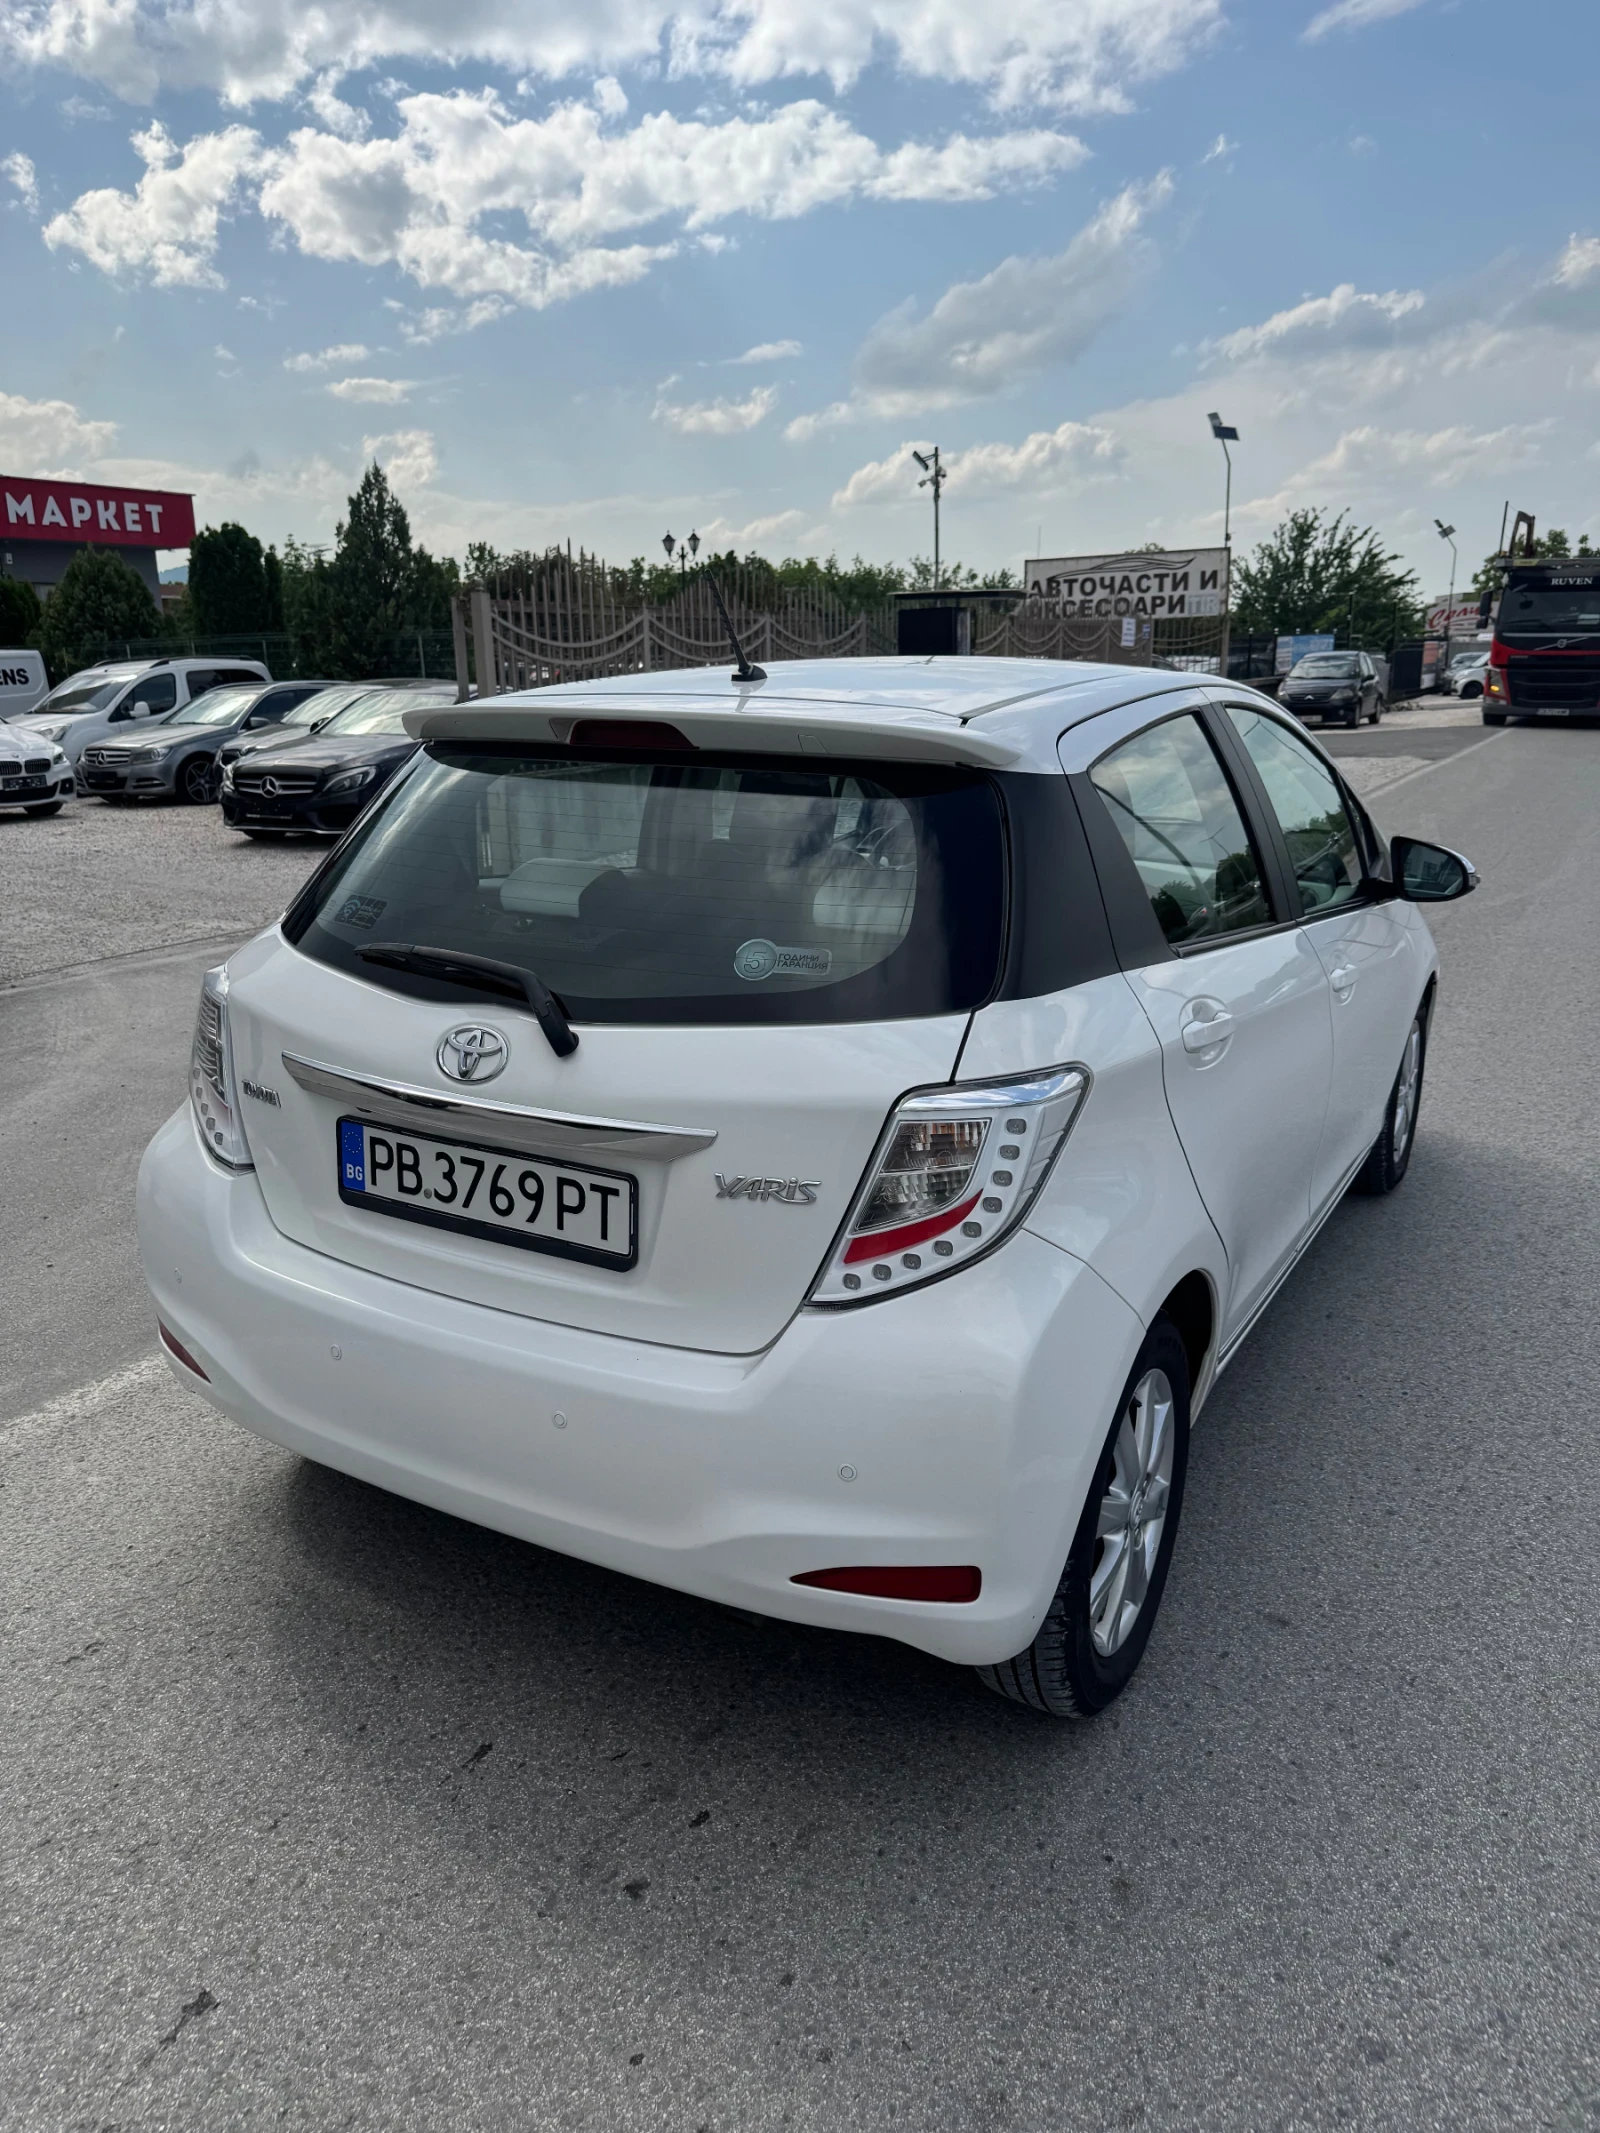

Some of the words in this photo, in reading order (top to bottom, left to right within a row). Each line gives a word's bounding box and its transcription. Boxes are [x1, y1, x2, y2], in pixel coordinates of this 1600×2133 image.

[5, 492, 164, 534] МАРКЕТ
[1028, 571, 1190, 599] АВТОЧАСТИ
[1200, 570, 1218, 590] И
[1551, 577, 1593, 586] RUVEN
[778, 953, 819, 962] ГОДИНИ
[777, 960, 828, 970] ГАРАНЦИЯ
[346, 1163, 363, 1181] BG
